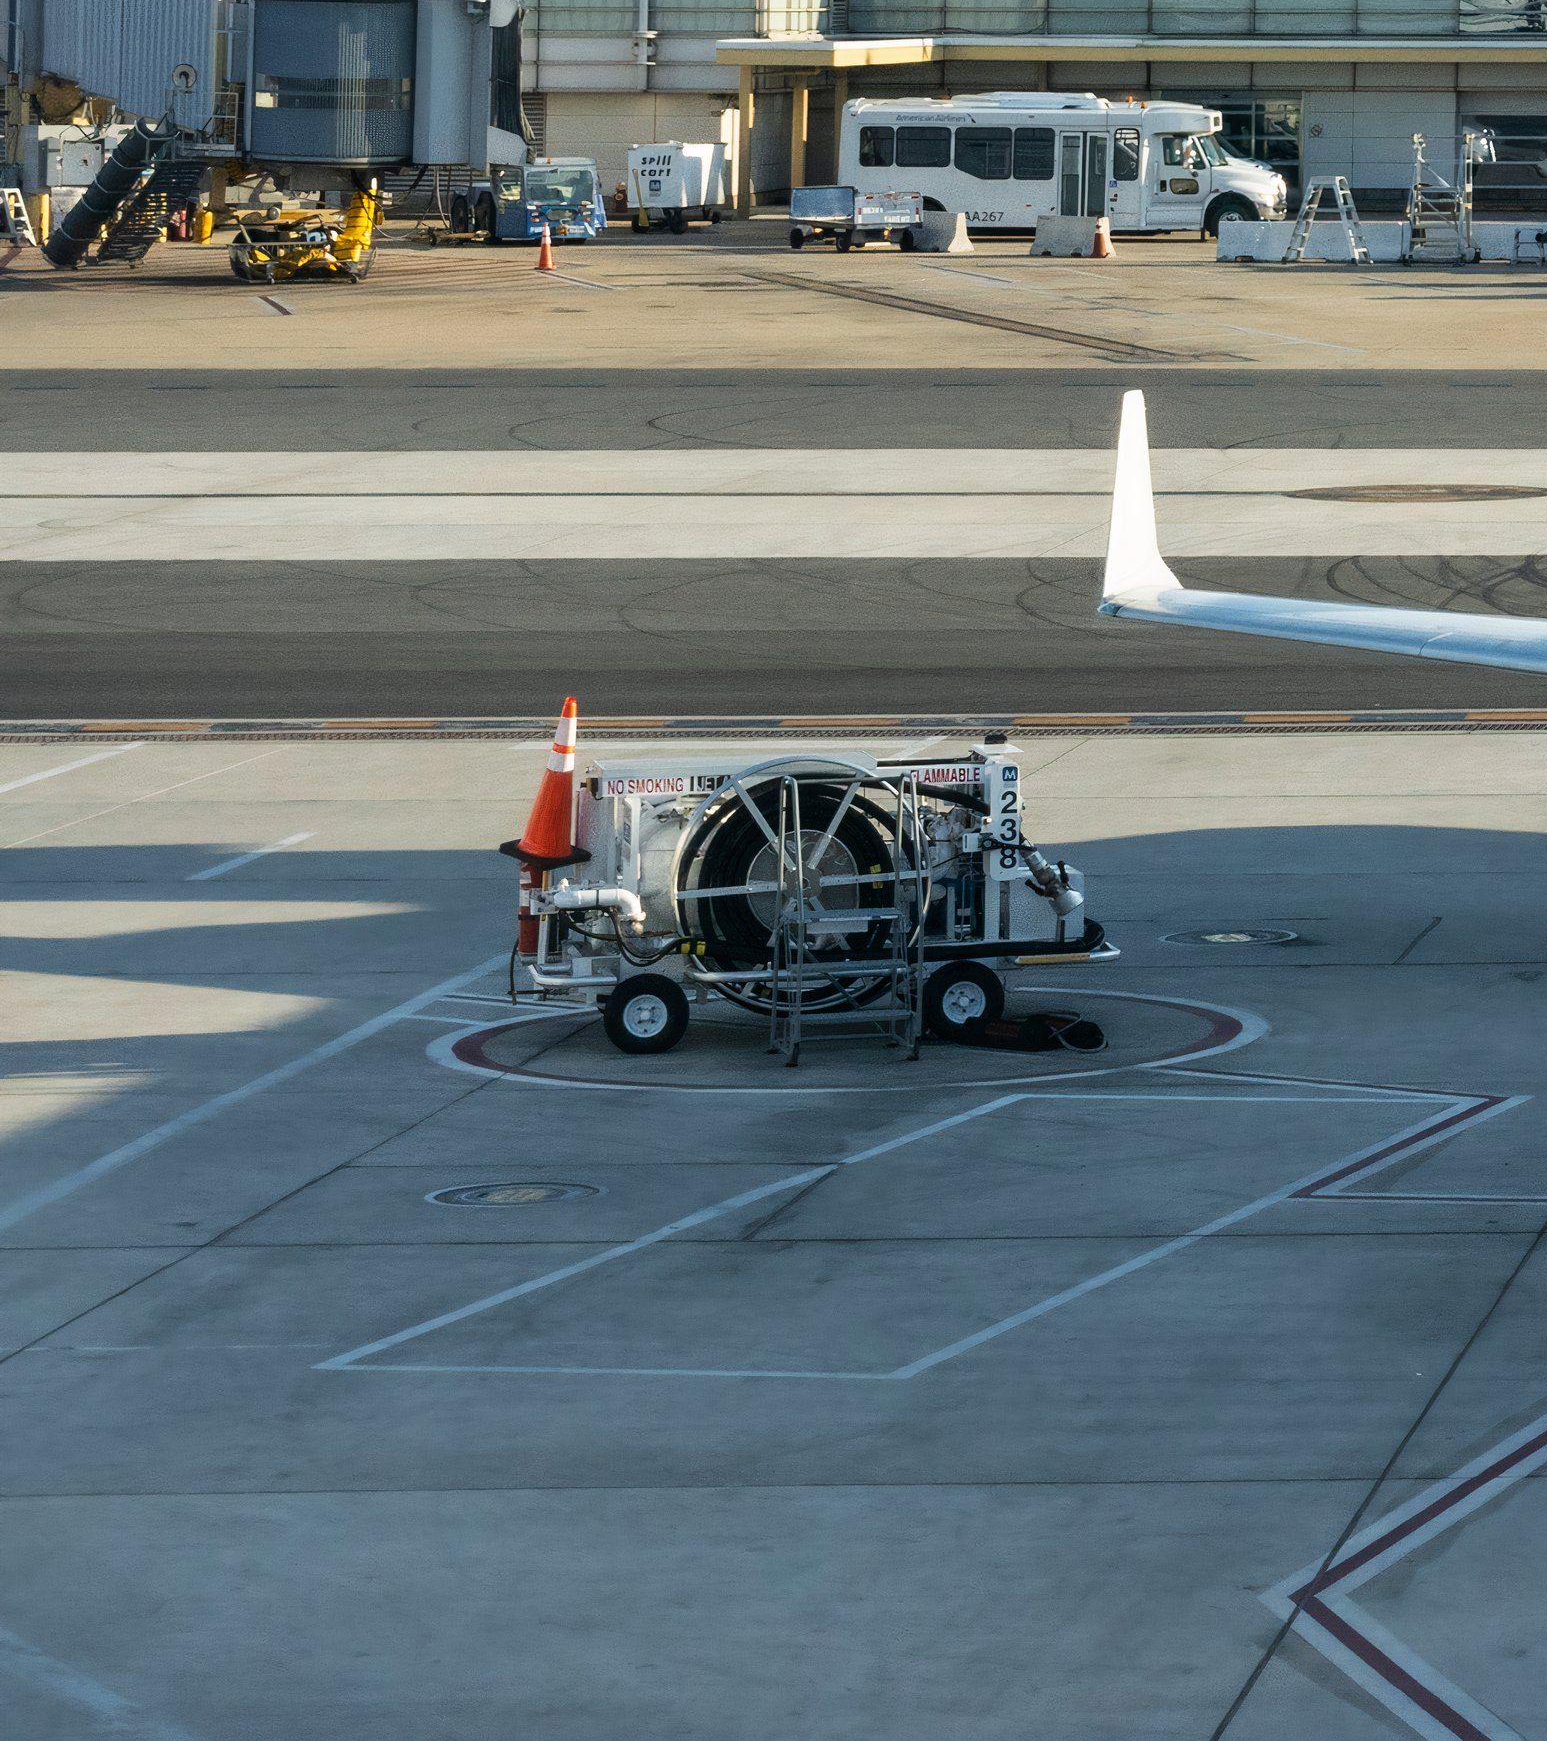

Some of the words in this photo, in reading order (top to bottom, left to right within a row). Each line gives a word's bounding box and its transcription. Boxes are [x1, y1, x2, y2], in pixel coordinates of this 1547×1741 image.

[641, 155, 672, 166] spill
[607, 779, 624, 795] NO
[627, 777, 684, 794] SMOKING
